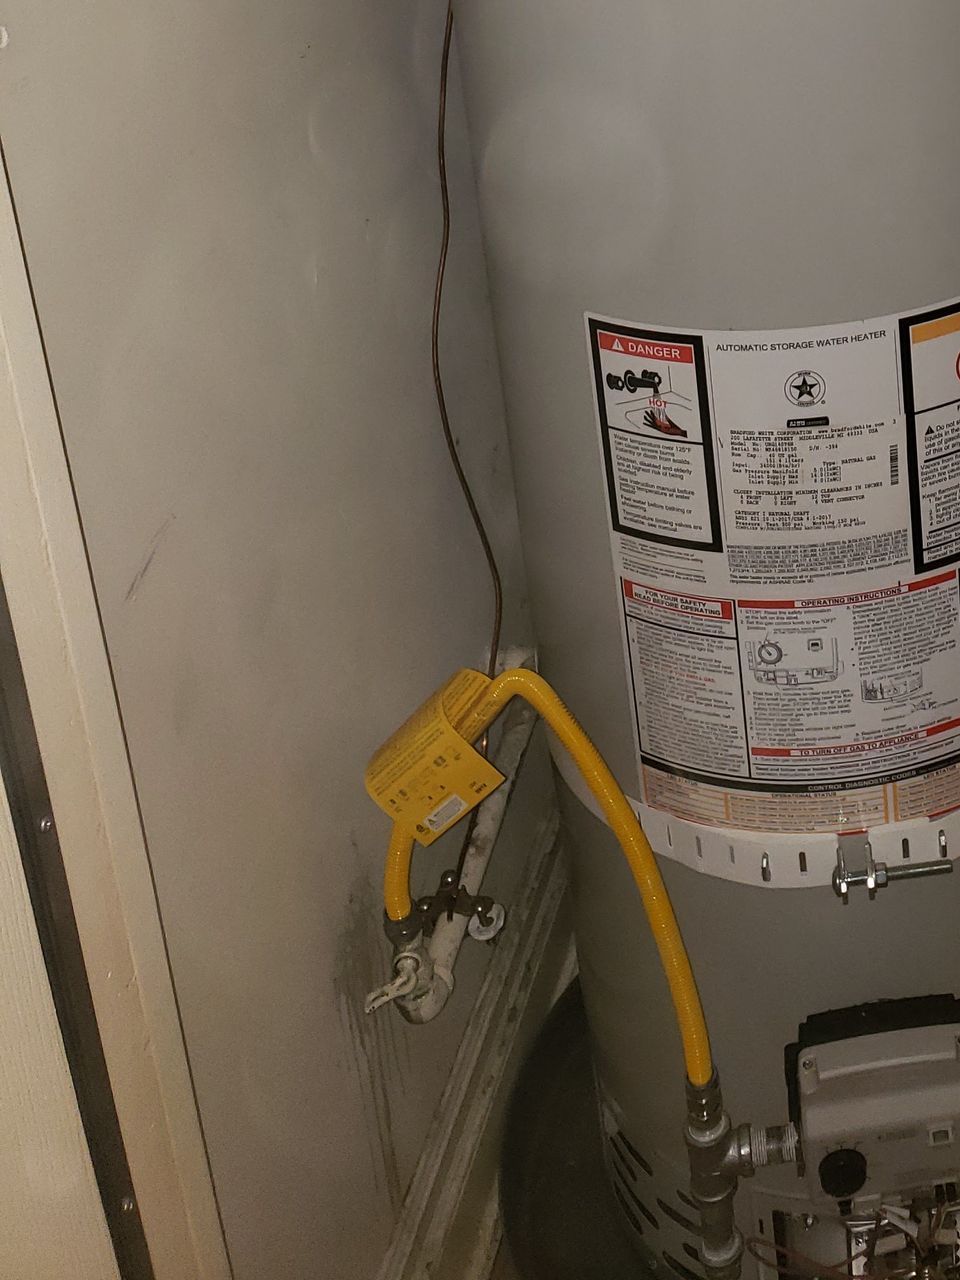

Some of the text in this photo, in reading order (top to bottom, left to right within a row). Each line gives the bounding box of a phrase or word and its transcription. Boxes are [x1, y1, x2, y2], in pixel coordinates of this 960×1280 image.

[628, 342, 681, 359] DANGER
[716, 330, 886, 352] AUTOMATIC STORAGE WATER HEATER
[649, 399, 668, 409] HOT
[634, 591, 720, 616] READ BEFORE OPERATING
[645, 589, 706, 608] FOR YOUR SAFETY
[800, 588, 902, 607] OPERATING INSTRUCTIONS
[811, 748, 831, 756] TURN
[833, 746, 848, 754] OFF
[849, 745, 865, 753] GAS
[879, 734, 919, 748] APPLIANCE
[808, 771, 916, 792] CONTROL DIAGNOSTIC CODES
